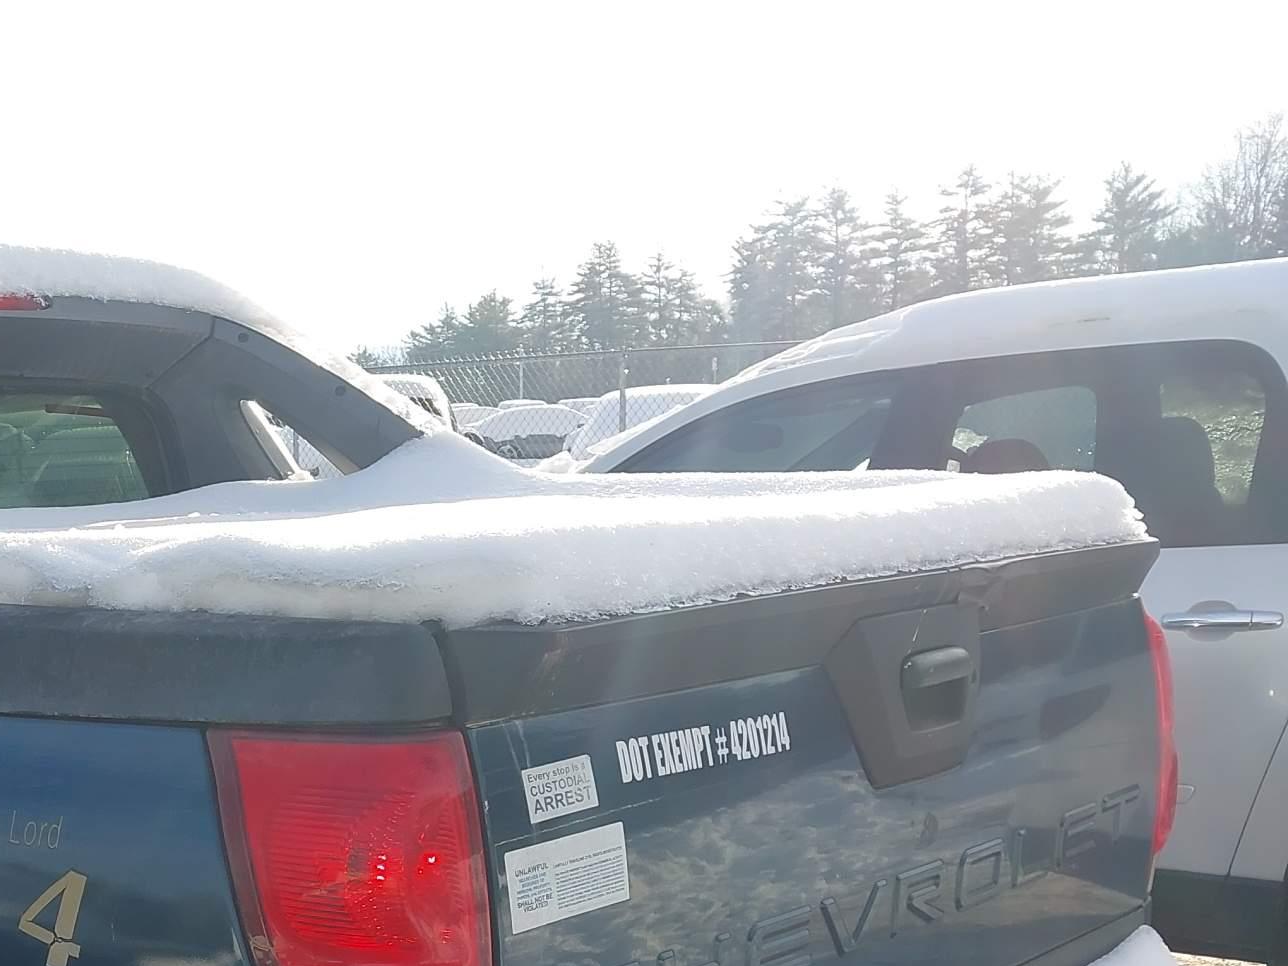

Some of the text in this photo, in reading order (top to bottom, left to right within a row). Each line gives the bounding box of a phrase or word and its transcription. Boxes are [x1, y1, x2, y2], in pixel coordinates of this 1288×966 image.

[616, 711, 791, 783] DOT EXEMPT # 4201214
[527, 771, 551, 783] Every
[553, 766, 570, 777] stop
[572, 763, 580, 773] is
[530, 772, 590, 797] CUSTODIAL
[534, 785, 591, 815] ARREST
[9, 810, 63, 849] Lord
